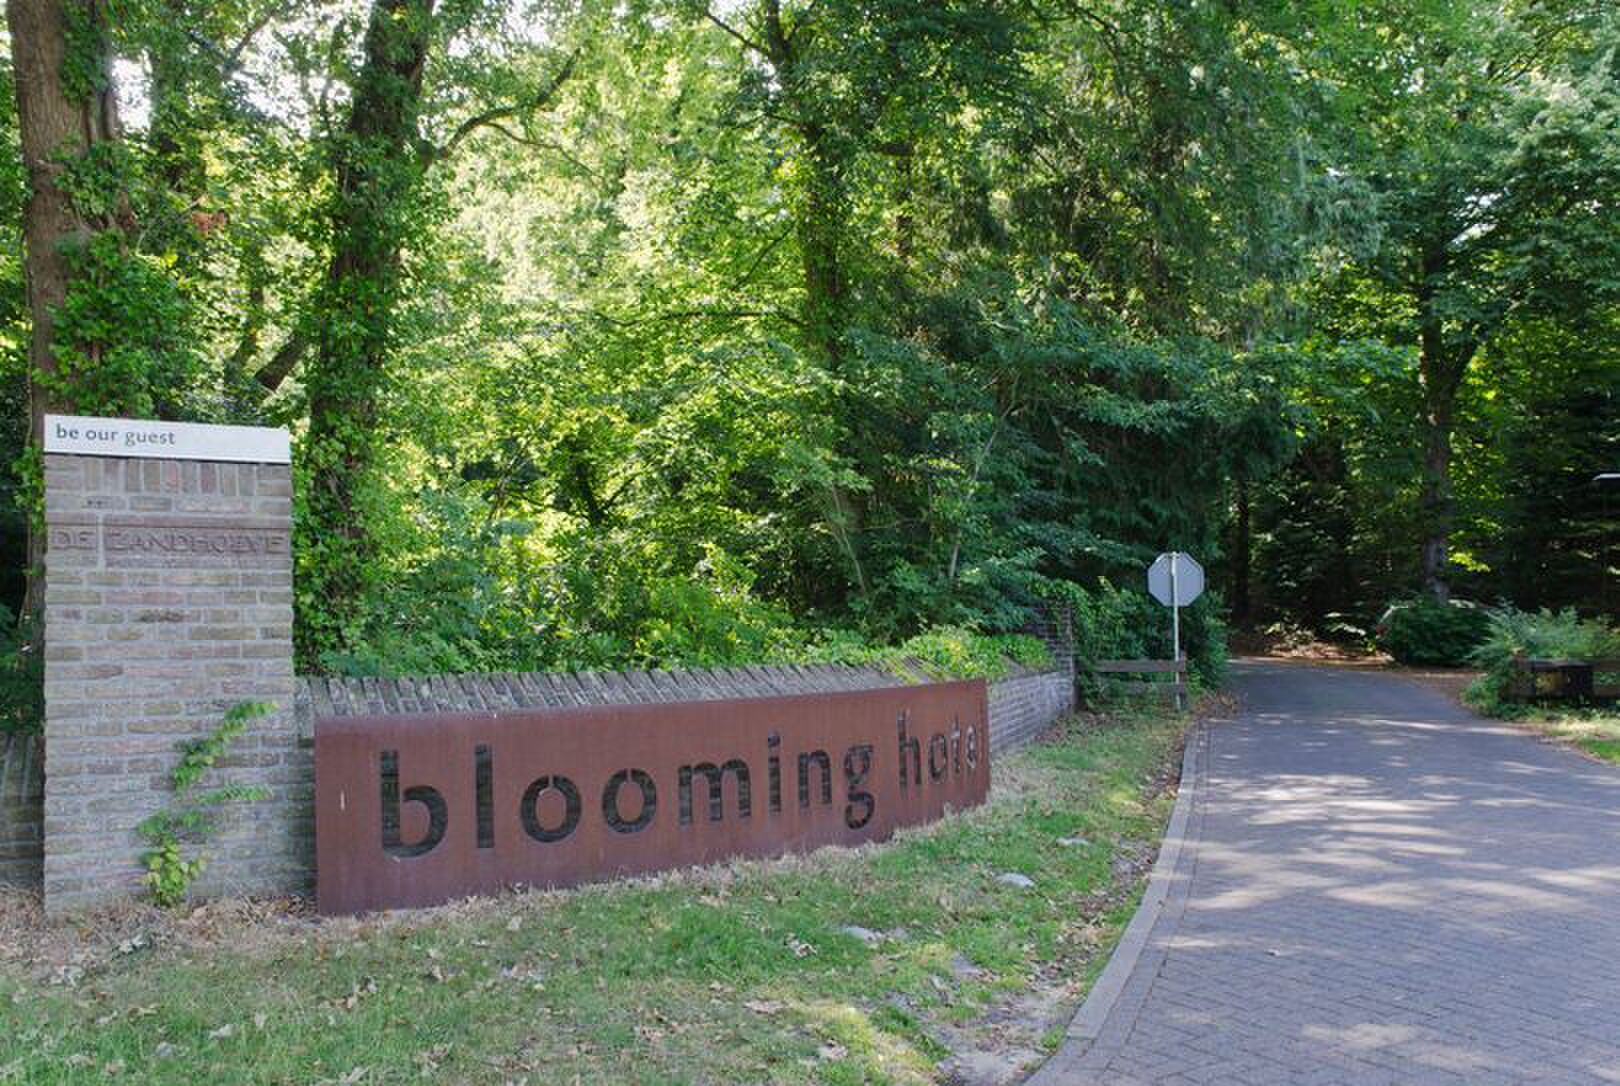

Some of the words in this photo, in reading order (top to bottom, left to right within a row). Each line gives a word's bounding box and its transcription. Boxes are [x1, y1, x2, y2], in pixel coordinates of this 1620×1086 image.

[56, 423, 79, 439] be
[85, 429, 119, 441] our
[126, 431, 177, 448] guest
[379, 730, 876, 858] blooming
